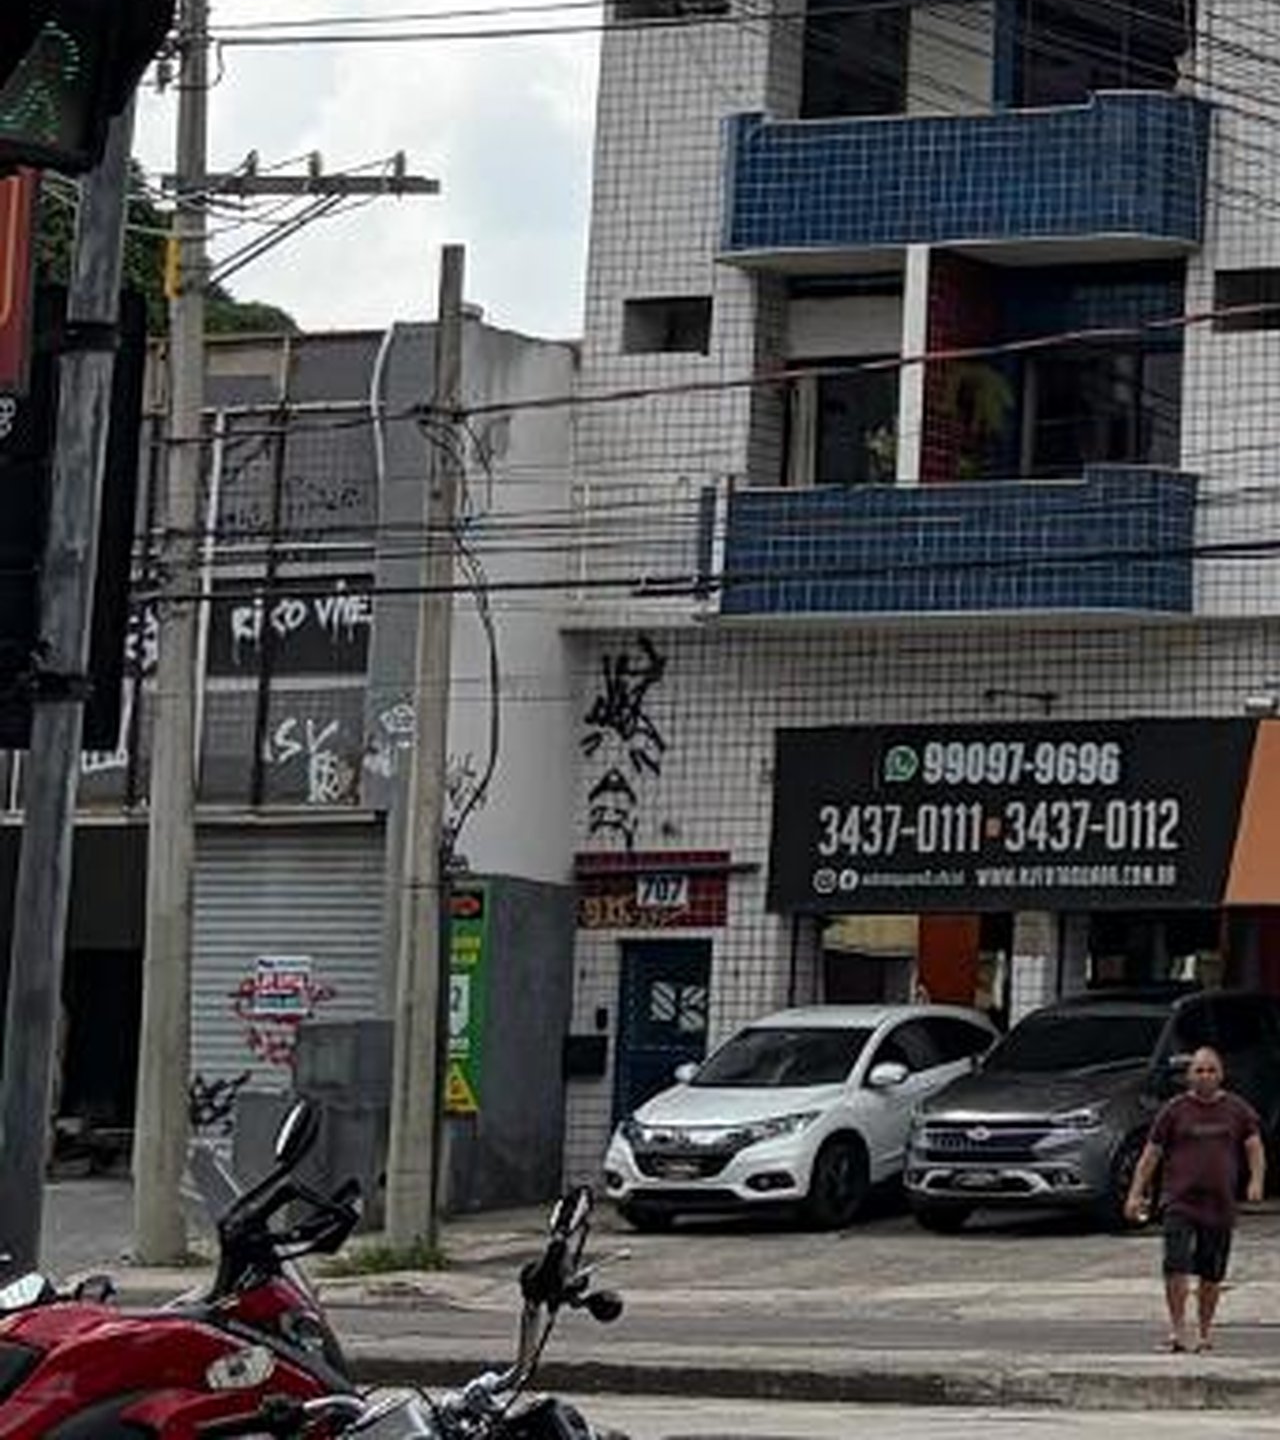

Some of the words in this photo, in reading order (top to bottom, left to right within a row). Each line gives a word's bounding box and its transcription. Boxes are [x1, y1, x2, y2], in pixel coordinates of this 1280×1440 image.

[923, 742, 1121, 785] 99097-9696
[819, 803, 982, 856] 3437-0111
[1005, 799, 1180, 853] 3437-0112
[641, 875, 685, 902] 707
